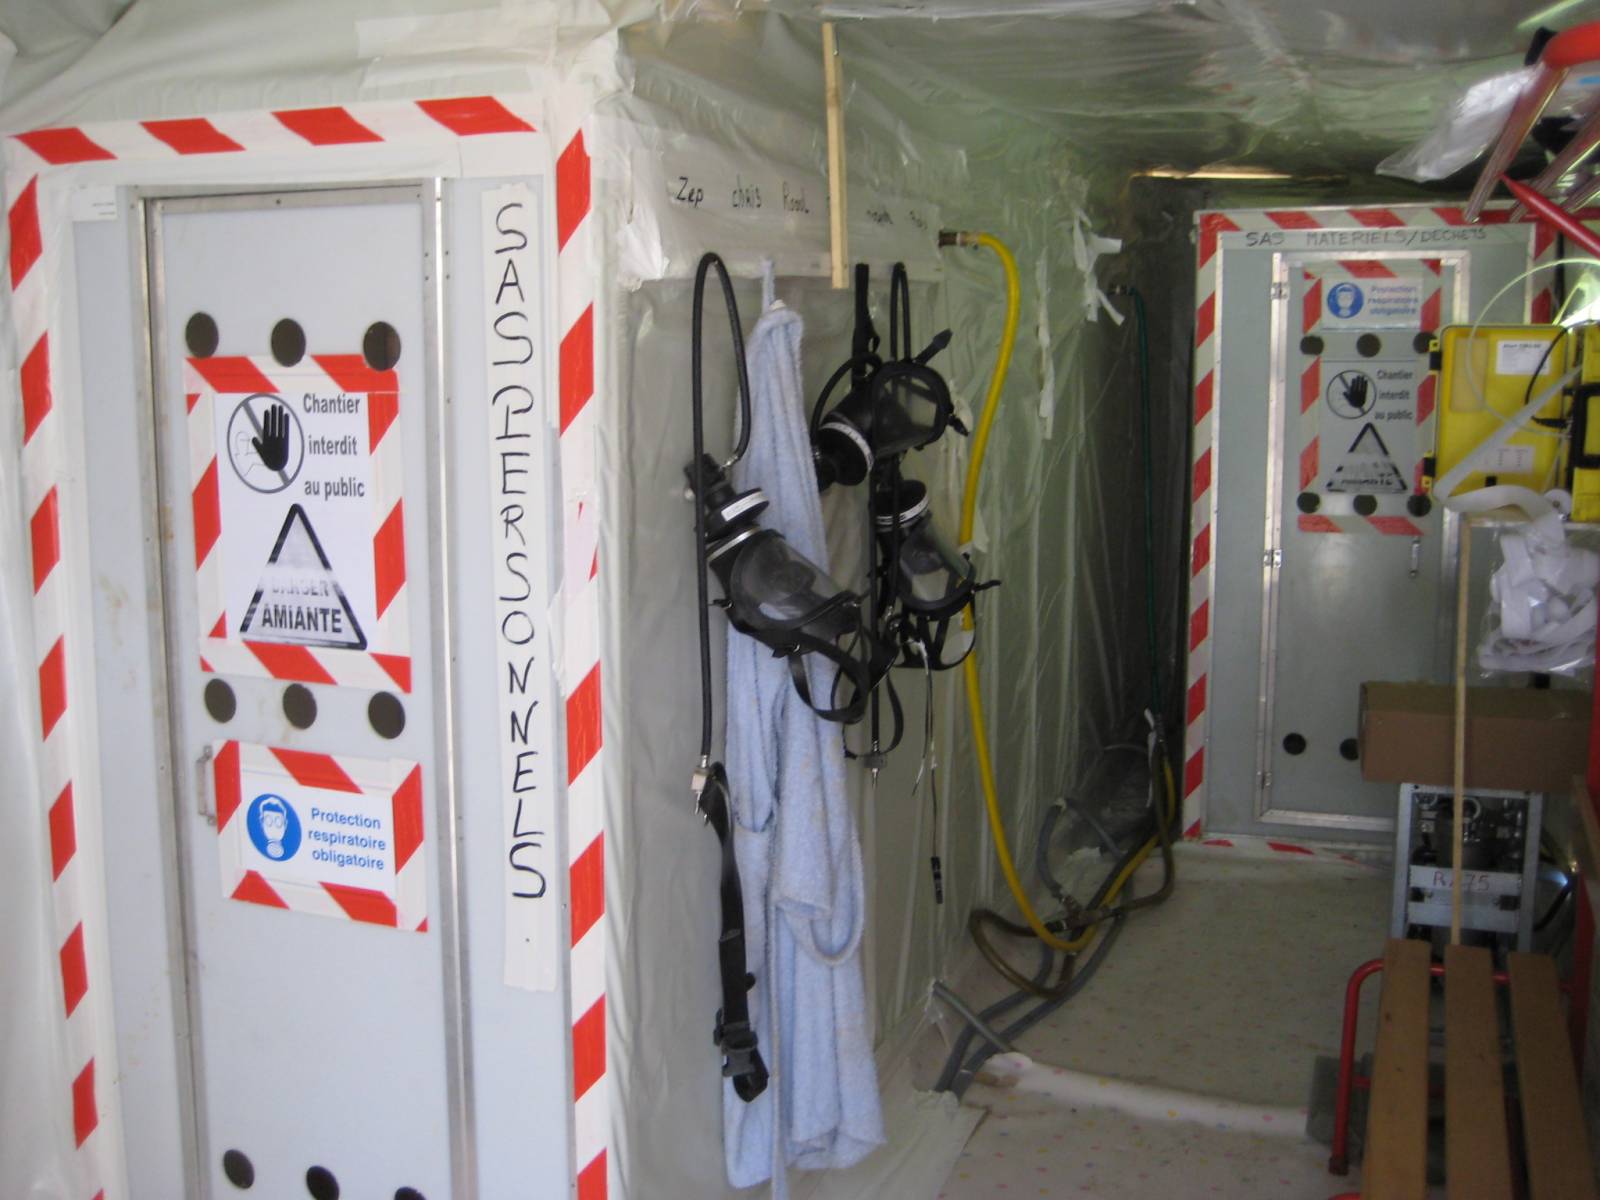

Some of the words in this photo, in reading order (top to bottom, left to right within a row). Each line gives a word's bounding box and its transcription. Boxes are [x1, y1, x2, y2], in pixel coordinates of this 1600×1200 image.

[676, 176, 704, 208] Zep
[1245, 231, 1285, 247] SAS
[303, 393, 361, 415] Chantier
[308, 435, 358, 456] interdit
[304, 480, 321, 496] au
[324, 477, 365, 500] public
[261, 603, 343, 634] AMIANTE
[311, 807, 381, 830] Protection
[308, 830, 386, 851] respiratoire
[312, 848, 384, 871] obligatoire
